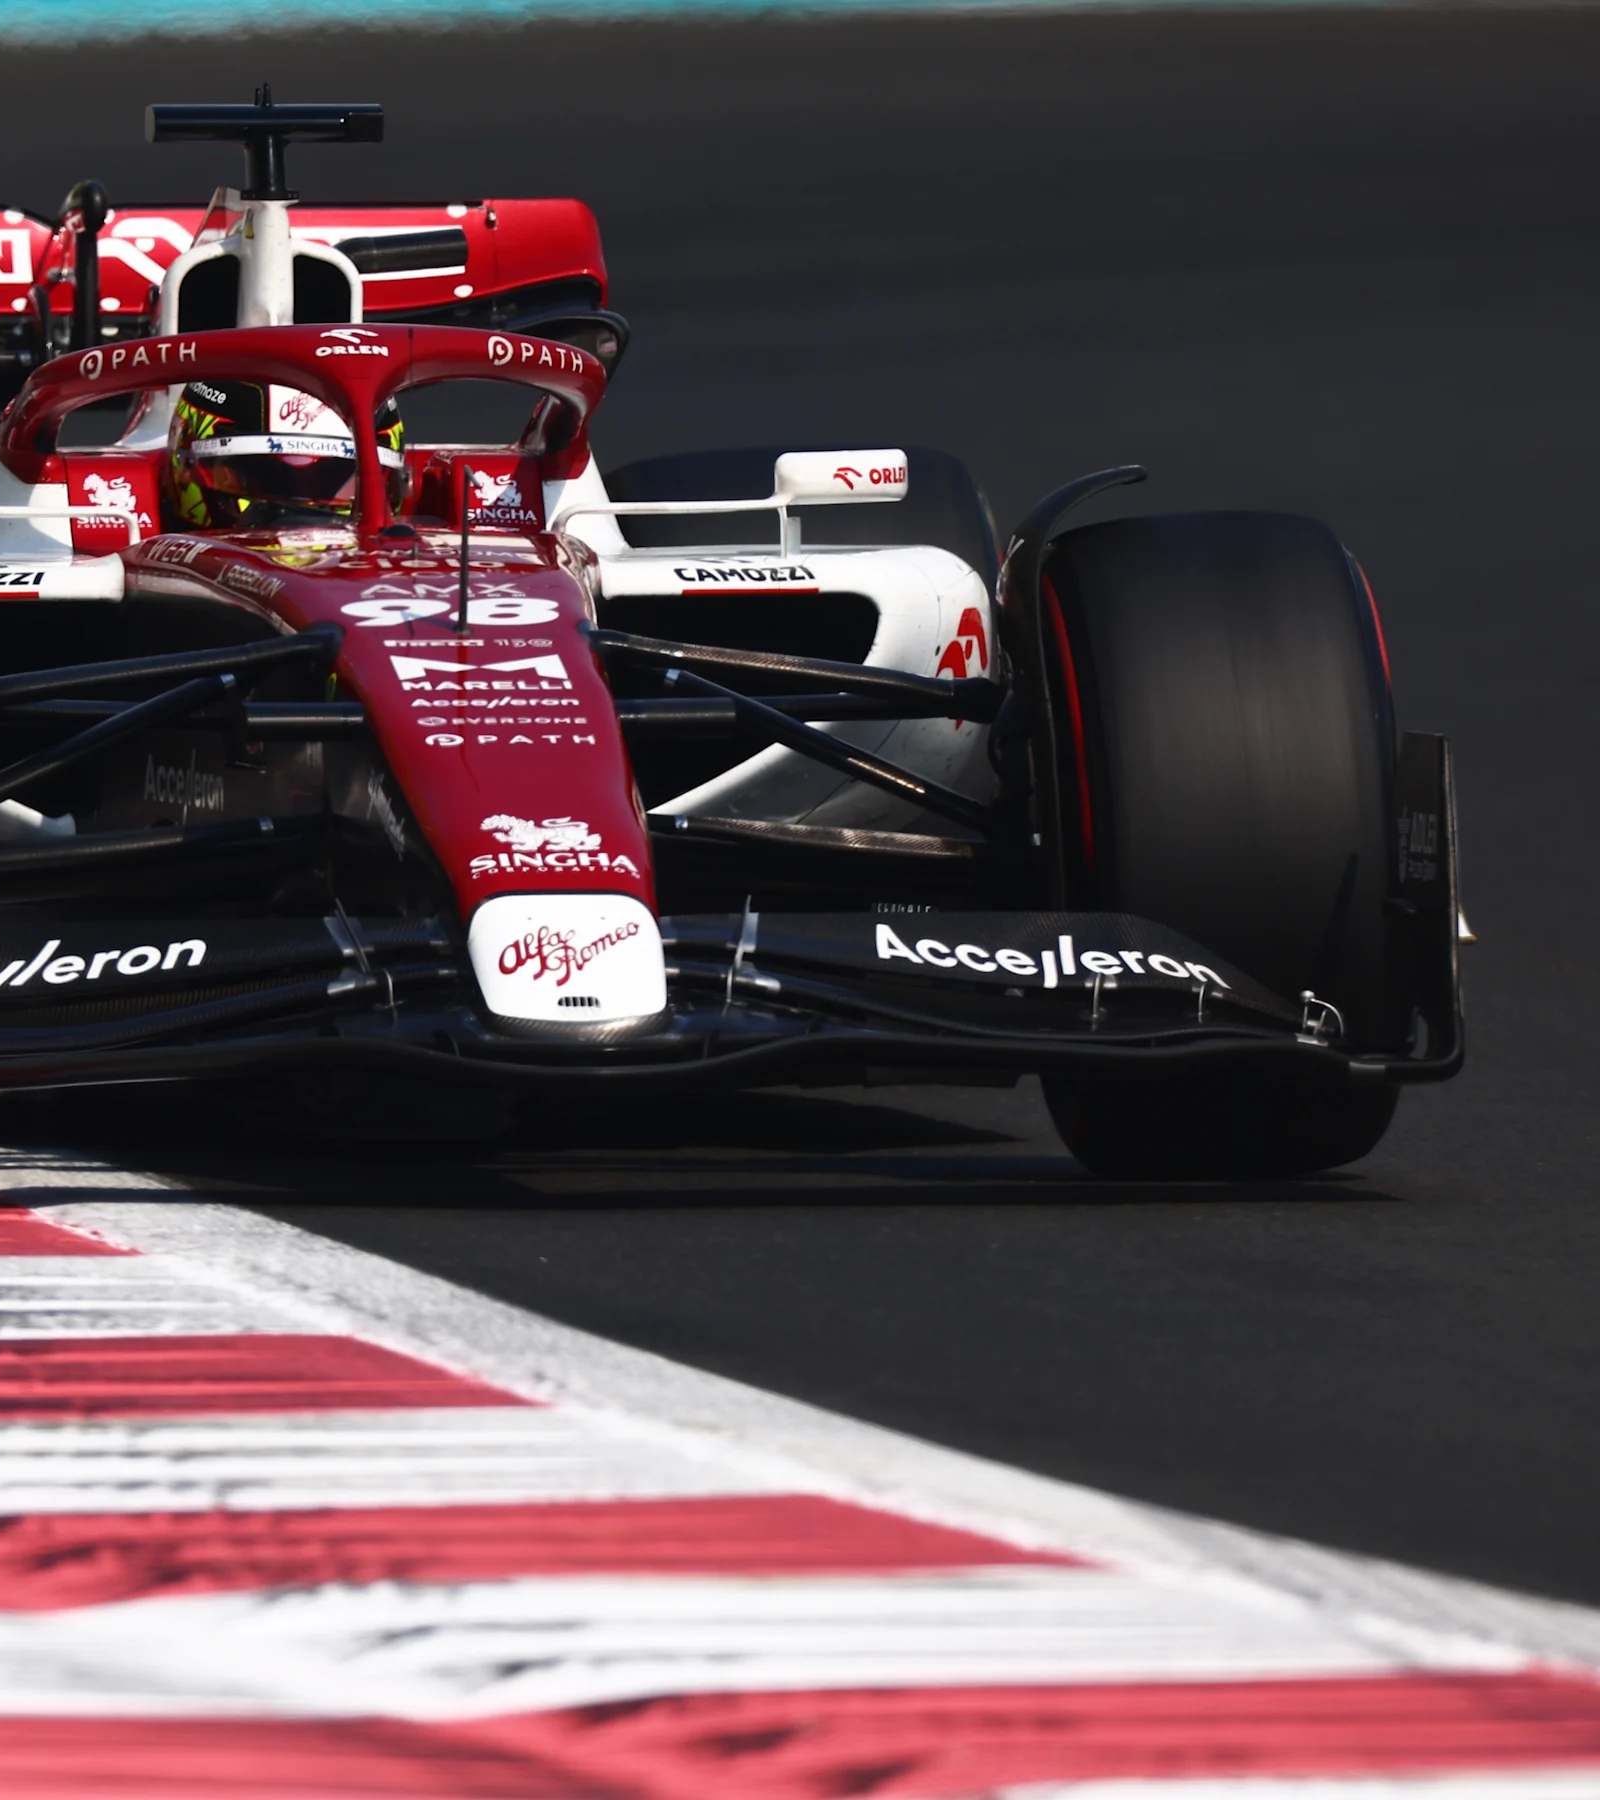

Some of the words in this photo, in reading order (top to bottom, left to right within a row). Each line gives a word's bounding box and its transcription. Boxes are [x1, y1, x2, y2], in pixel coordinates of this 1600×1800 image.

[112, 341, 196, 370] PATH
[315, 344, 389, 357] ORLEN
[522, 341, 585, 374] PATH
[286, 442, 339, 454] SINGHA
[77, 513, 151, 524] SINGA
[674, 566, 816, 582] CAMOZZI
[360, 583, 527, 597] AMX
[341, 599, 560, 627] 98
[401, 682, 573, 690] MARELLI
[412, 696, 579, 708] Accelleron
[451, 716, 587, 725] EVERDOME
[477, 735, 595, 745] PATH
[143, 748, 225, 824] Accelleron
[469, 853, 638, 872] SINGHA
[472, 867, 641, 880] CORPORATION
[499, 926, 566, 981] Alfa
[545, 921, 639, 987] Romeo
[875, 923, 1232, 989] Accelleron
